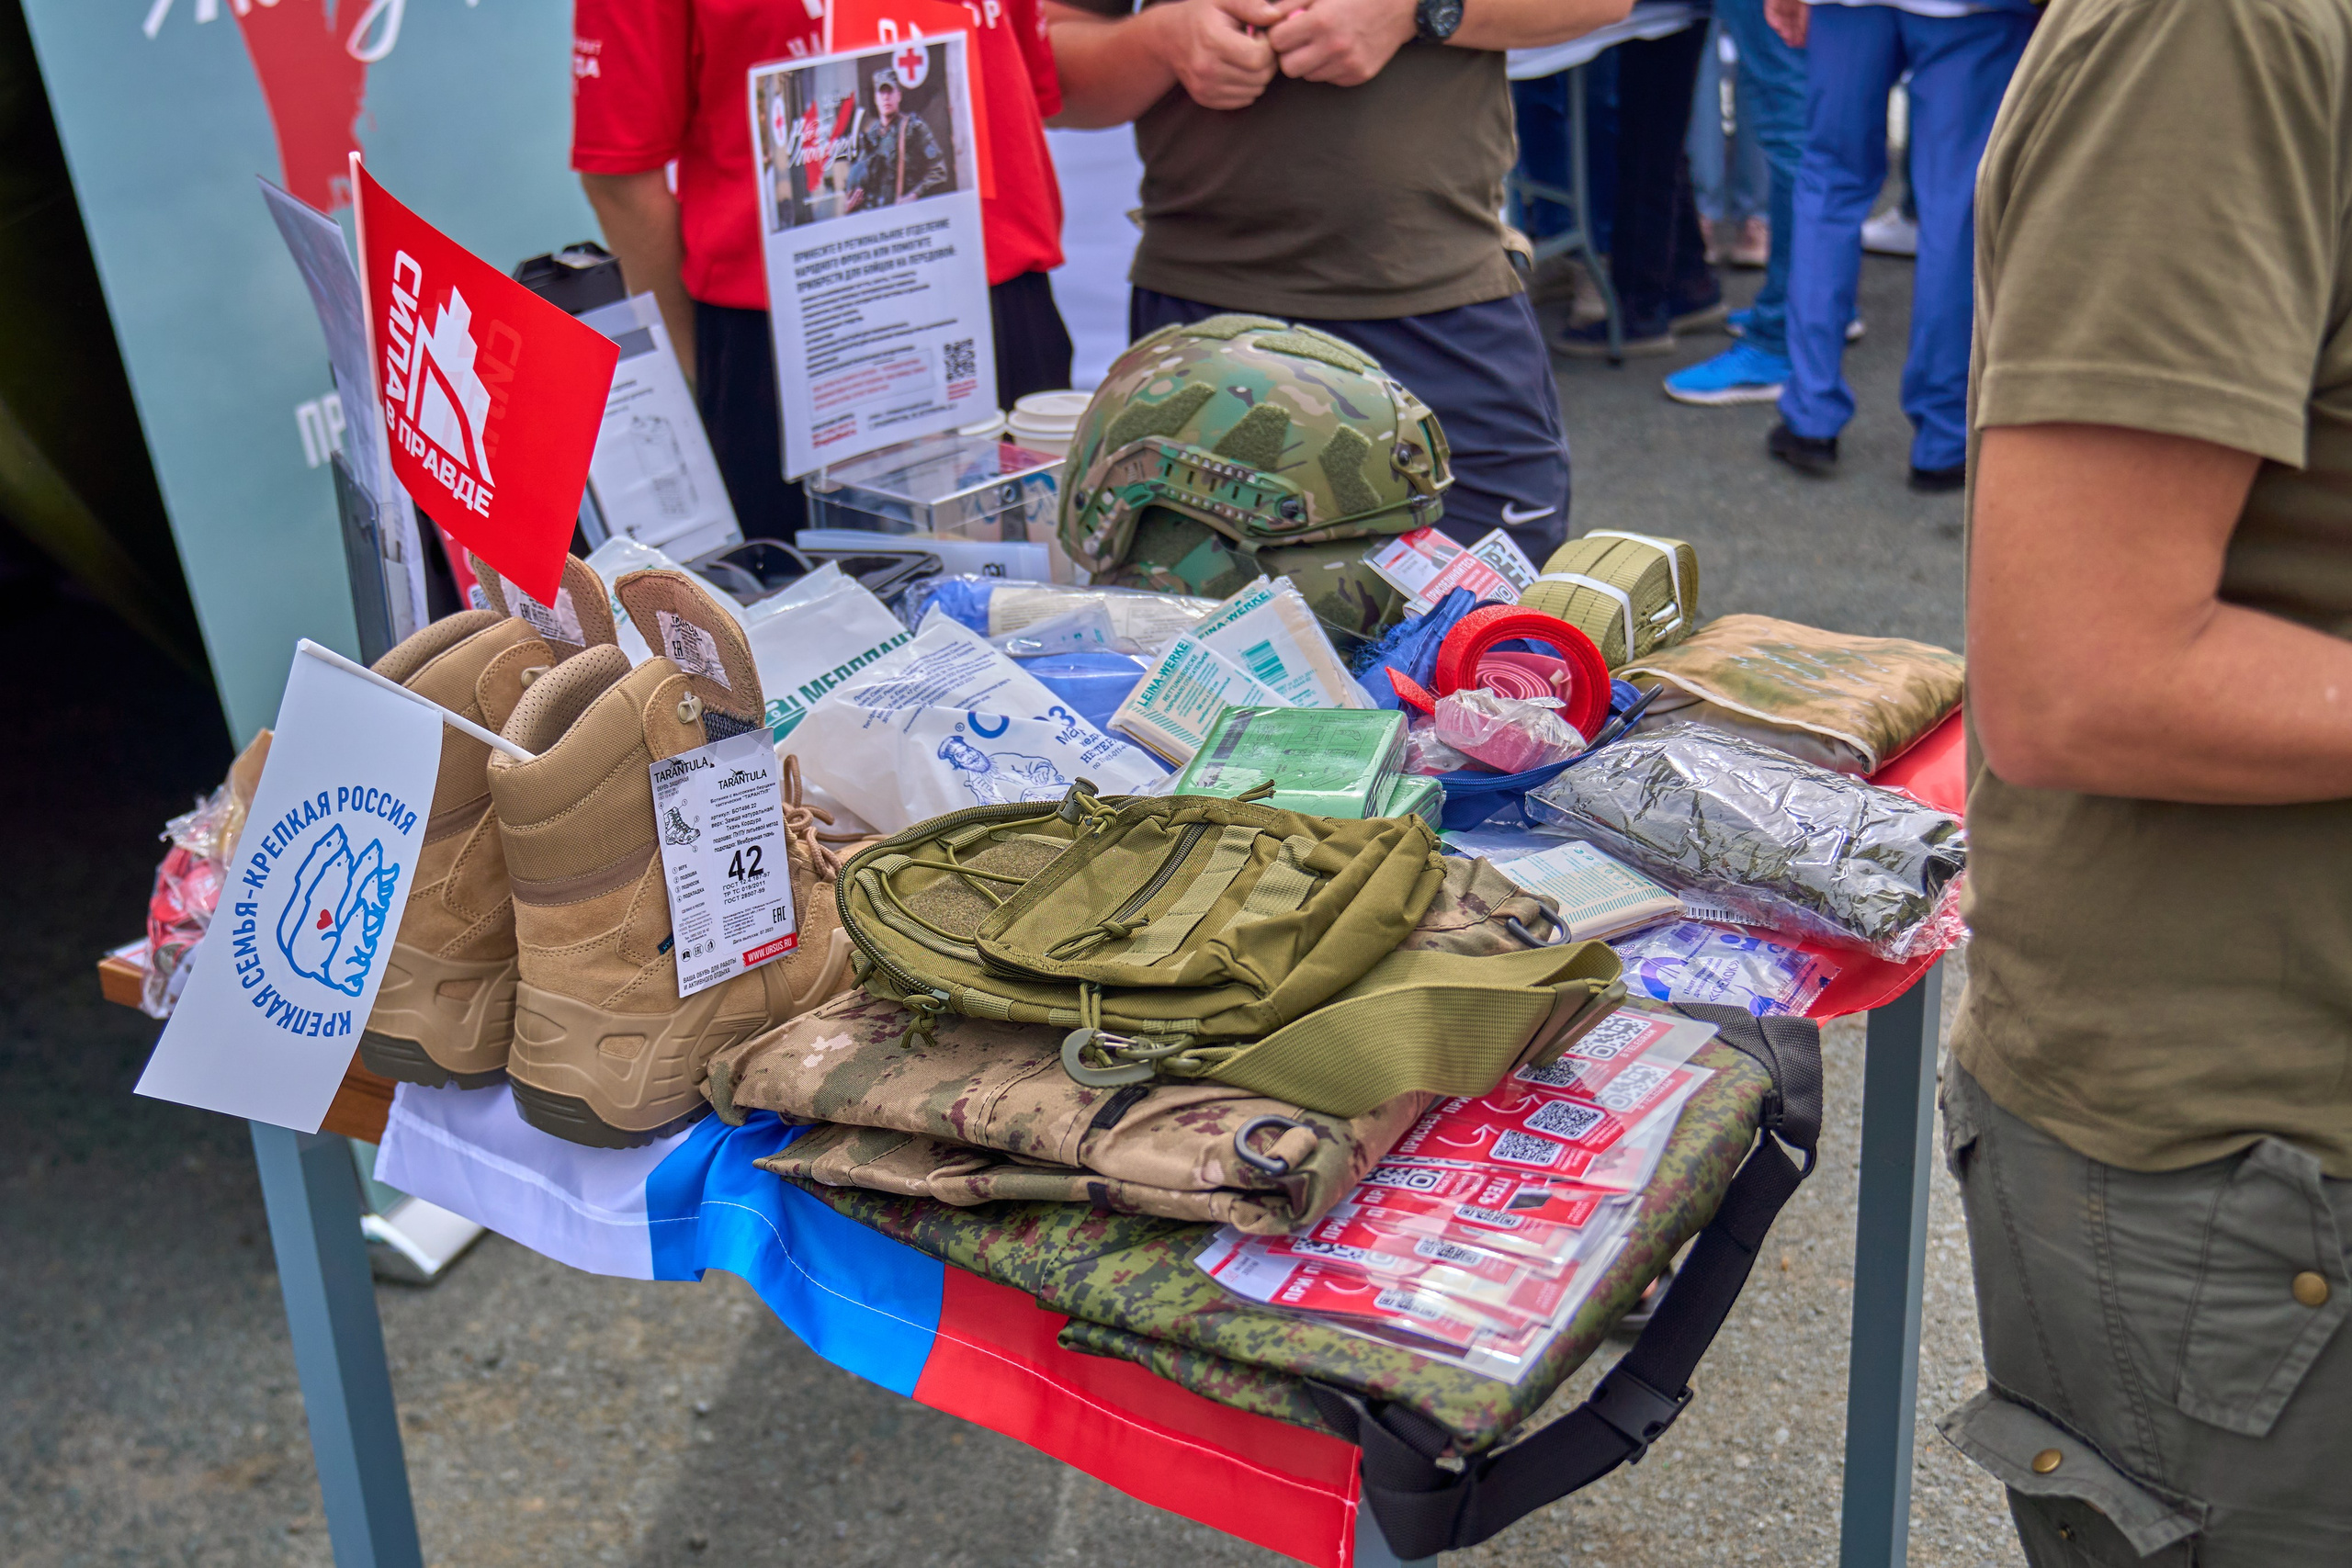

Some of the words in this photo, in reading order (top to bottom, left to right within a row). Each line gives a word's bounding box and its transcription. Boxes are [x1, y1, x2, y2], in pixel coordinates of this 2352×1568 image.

[386, 250, 423, 402] СИЛА
[386, 398, 395, 432] В
[398, 417, 493, 519] ПРАВДЕ
[1425, 555, 1477, 603] ПРИСОЕДИНЯЙТЕСЬ
[1136, 639, 1189, 708] LEINA-WERKE
[1161, 652, 1198, 703] RETTUNGSDECKE
[1163, 684, 1185, 714] ПОКРЫВАЛО
[1182, 649, 1210, 686] СПАСАТЕЛЬНОЕ
[653, 756, 708, 783] TARANTULA
[718, 767, 766, 791] TARANTULA
[709, 795, 728, 803] Ботинки
[732, 787, 755, 796] высокими
[756, 781, 775, 790] берцами
[715, 796, 741, 807] тактические
[337, 785, 418, 836] РОССИЯ
[710, 810, 730, 820] артикул:
[724, 814, 741, 824] Замша
[726, 822, 740, 830] Ткань
[741, 816, 761, 827] Кордура
[712, 833, 732, 843] подошва:
[765, 820, 778, 829] метод
[763, 829, 774, 838] ткань
[728, 844, 764, 881] 42
[232, 791, 332, 988] СЕМЬЯ-КРЕПКАЯ
[682, 887, 705, 898] ПОДКЛАДКА
[722, 881, 739, 890] ГОСТ
[724, 896, 740, 905] ГОСТ
[741, 886, 765, 898] 28507-99
[773, 906, 786, 923] EAC
[747, 937, 793, 962] WWW.URSUS.RU
[683, 974, 695, 983] ВАША
[695, 968, 709, 977] ОБУВЬ
[719, 957, 737, 968] РАБОТЫ
[687, 974, 713, 988] АКТИВНОГО
[713, 967, 730, 978] ОТДЫХА
[252, 984, 351, 1037] КРЕПКАЯ
[1627, 1029, 1657, 1055] TELEGRAM
[1644, 1077, 1676, 1104] TELEGRAM
